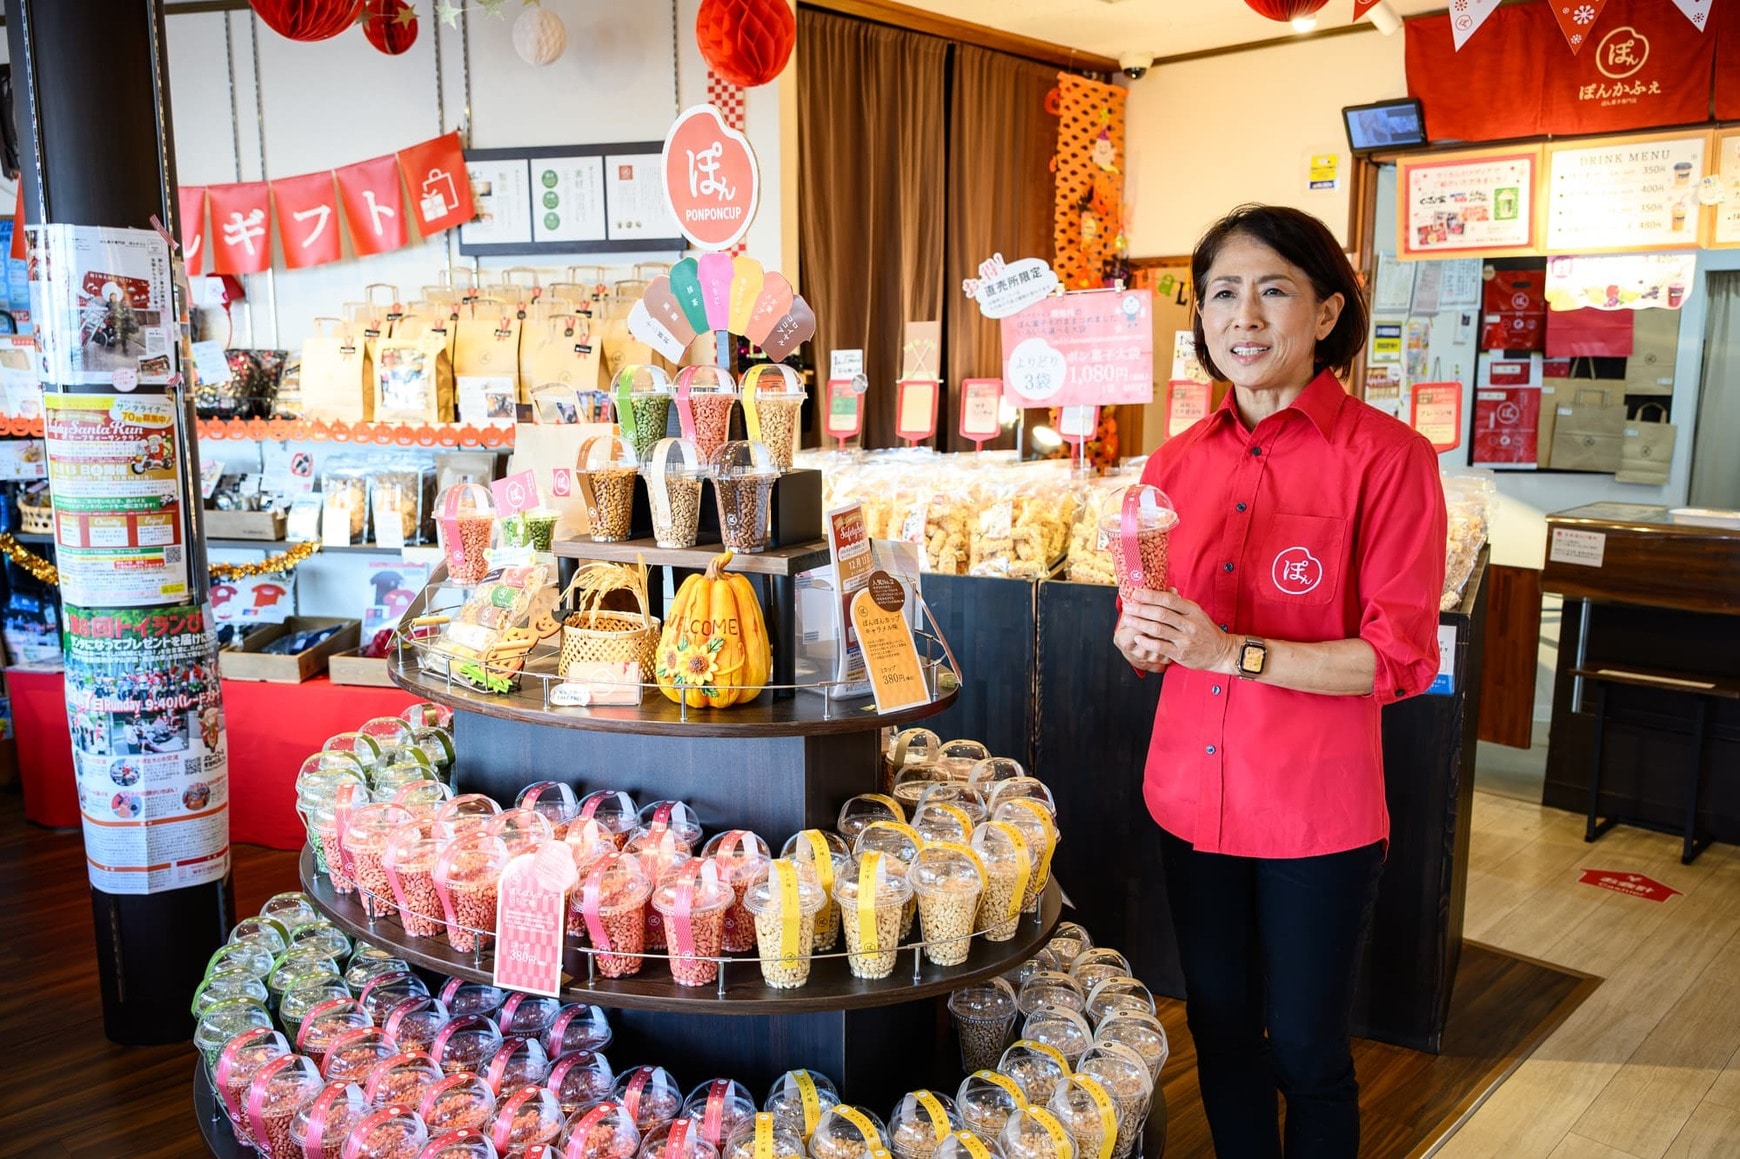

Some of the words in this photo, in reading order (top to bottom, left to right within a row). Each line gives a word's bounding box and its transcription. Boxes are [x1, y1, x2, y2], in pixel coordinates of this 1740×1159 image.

[1579, 80, 1661, 100] ぽんかふぇ
[1580, 152, 1623, 167] DRINK
[1629, 150, 1671, 162] MENU
[685, 141, 736, 201] ぽん
[686, 207, 741, 222] PONPONCUP
[984, 266, 1043, 298] 直売所限定
[1016, 356, 1058, 369] よりどり
[1024, 373, 1051, 390] 3袋
[1070, 364, 1128, 384] 1,080円
[68, 421, 110, 435] Santa
[110, 421, 144, 435] Run
[666, 612, 738, 636] WELCOME
[862, 615, 901, 626] ぽんぽんカップ
[866, 625, 898, 634] キャラメル味
[883, 673, 905, 685] 380円
